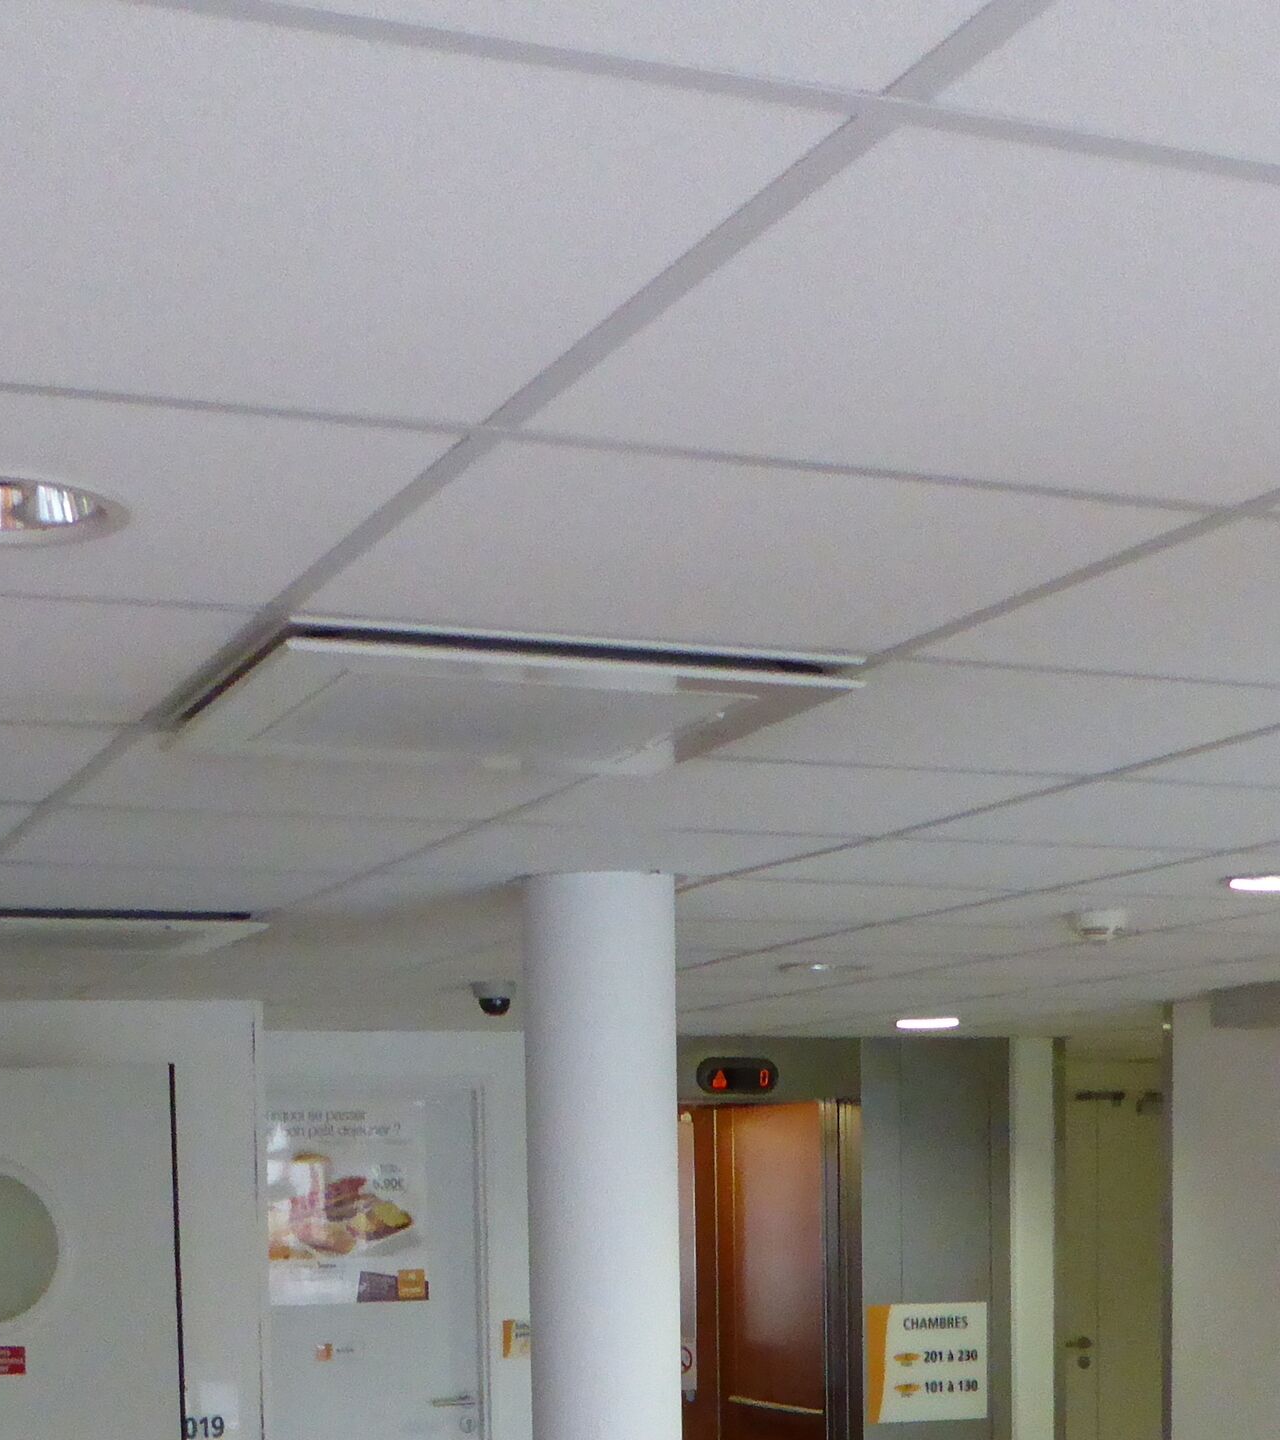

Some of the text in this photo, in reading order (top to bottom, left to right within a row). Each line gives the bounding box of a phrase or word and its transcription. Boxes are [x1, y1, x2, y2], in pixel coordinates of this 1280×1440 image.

[903, 1315, 968, 1331] CHAMBRES
[924, 1350, 943, 1363] 201
[958, 1349, 978, 1362] 230
[925, 1381, 943, 1393] 101
[185, 1416, 224, 1440] 019
